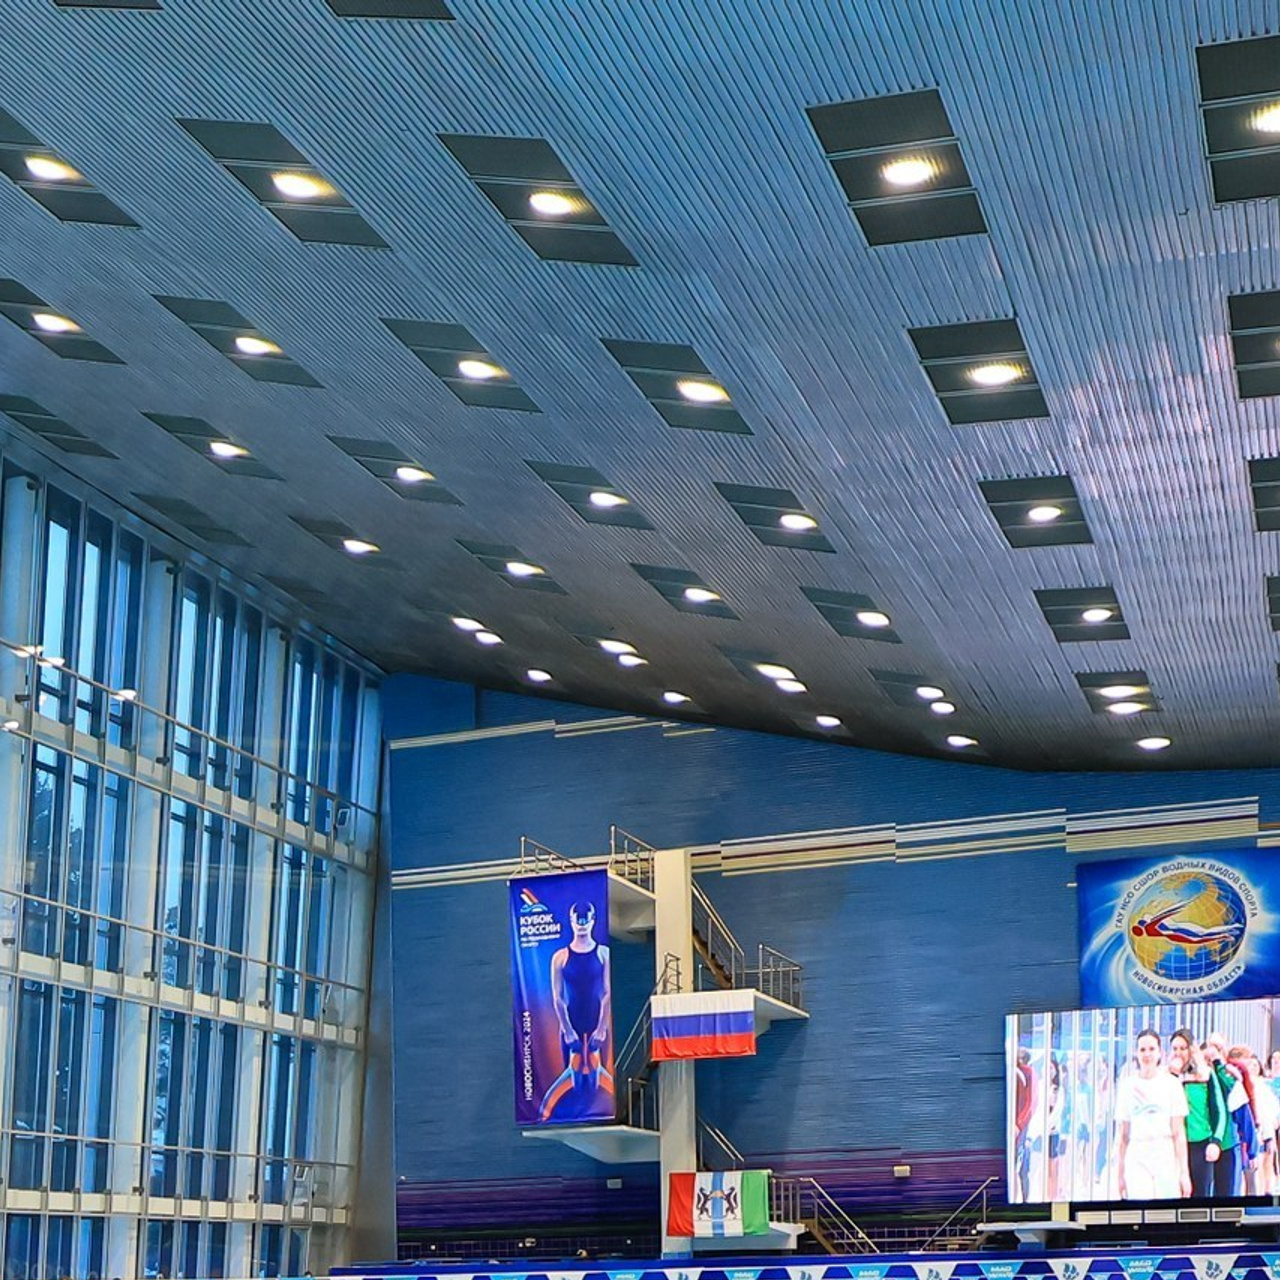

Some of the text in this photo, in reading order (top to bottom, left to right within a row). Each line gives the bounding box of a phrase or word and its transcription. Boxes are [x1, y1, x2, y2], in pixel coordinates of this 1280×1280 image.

[1133, 869, 1159, 891] СШОР
[1161, 861, 1207, 873] ВОДНЫХ
[1208, 863, 1241, 884] ВИДОВ
[1239, 882, 1258, 918] СПОРТА
[520, 914, 553, 925] КУБОК
[520, 923, 561, 935] РОССИИ
